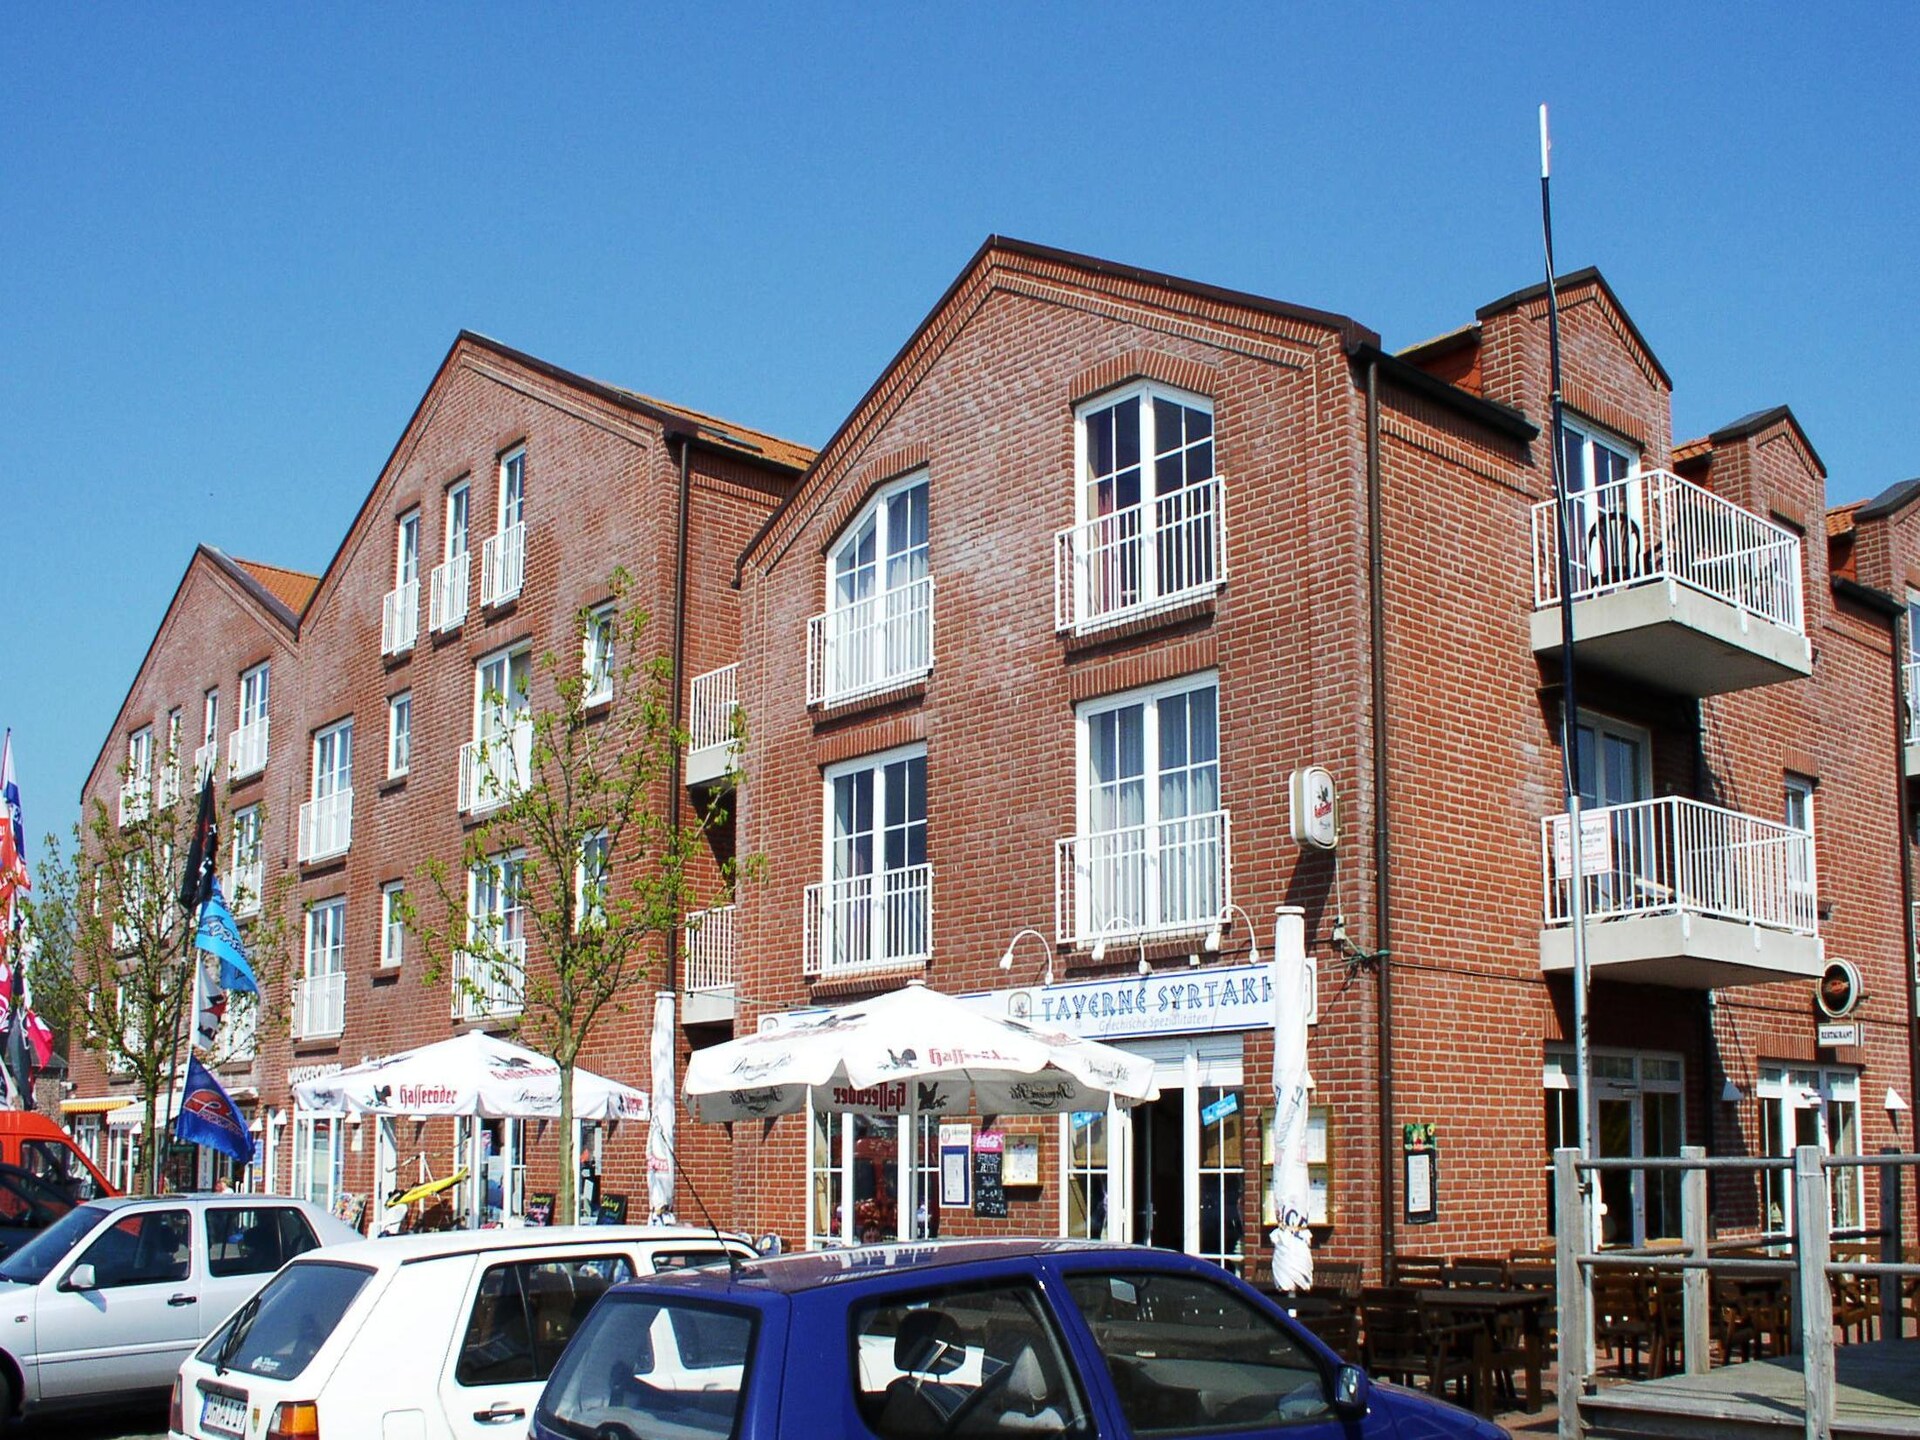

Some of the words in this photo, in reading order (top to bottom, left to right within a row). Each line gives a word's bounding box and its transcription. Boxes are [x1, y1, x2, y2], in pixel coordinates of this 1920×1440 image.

[1042, 988, 1147, 1022] TAVERNE
[1158, 976, 1270, 1012] SYRTAKI
[400, 1083, 458, 1109] Hasseröder
